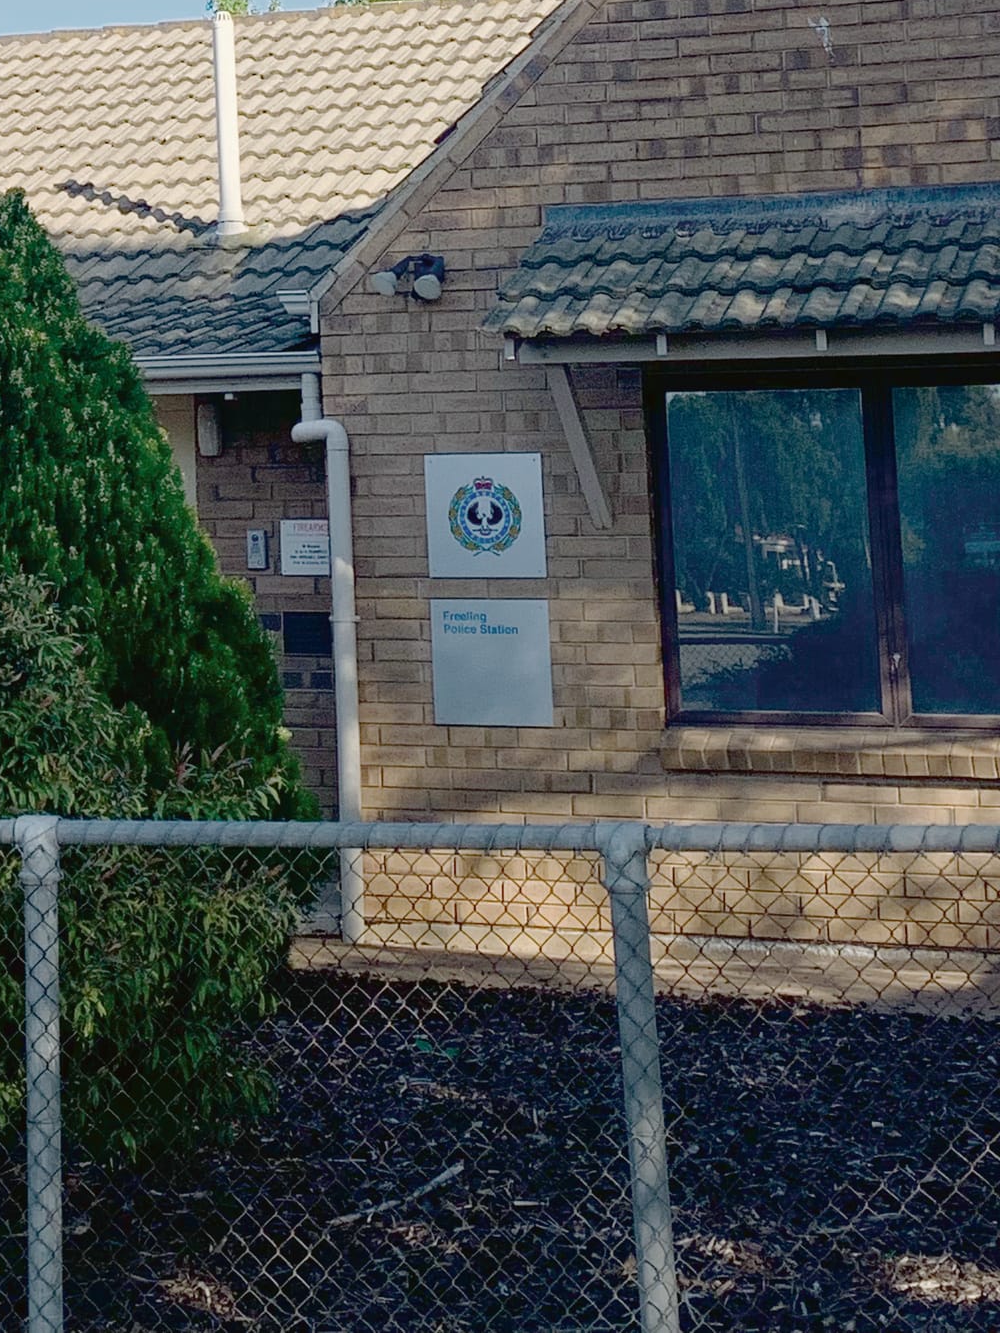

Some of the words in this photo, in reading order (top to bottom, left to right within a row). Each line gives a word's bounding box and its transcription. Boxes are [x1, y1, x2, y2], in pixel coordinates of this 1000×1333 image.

[443, 611, 487, 623] Freeling
[444, 624, 477, 634] Police
[480, 624, 519, 634] Station
